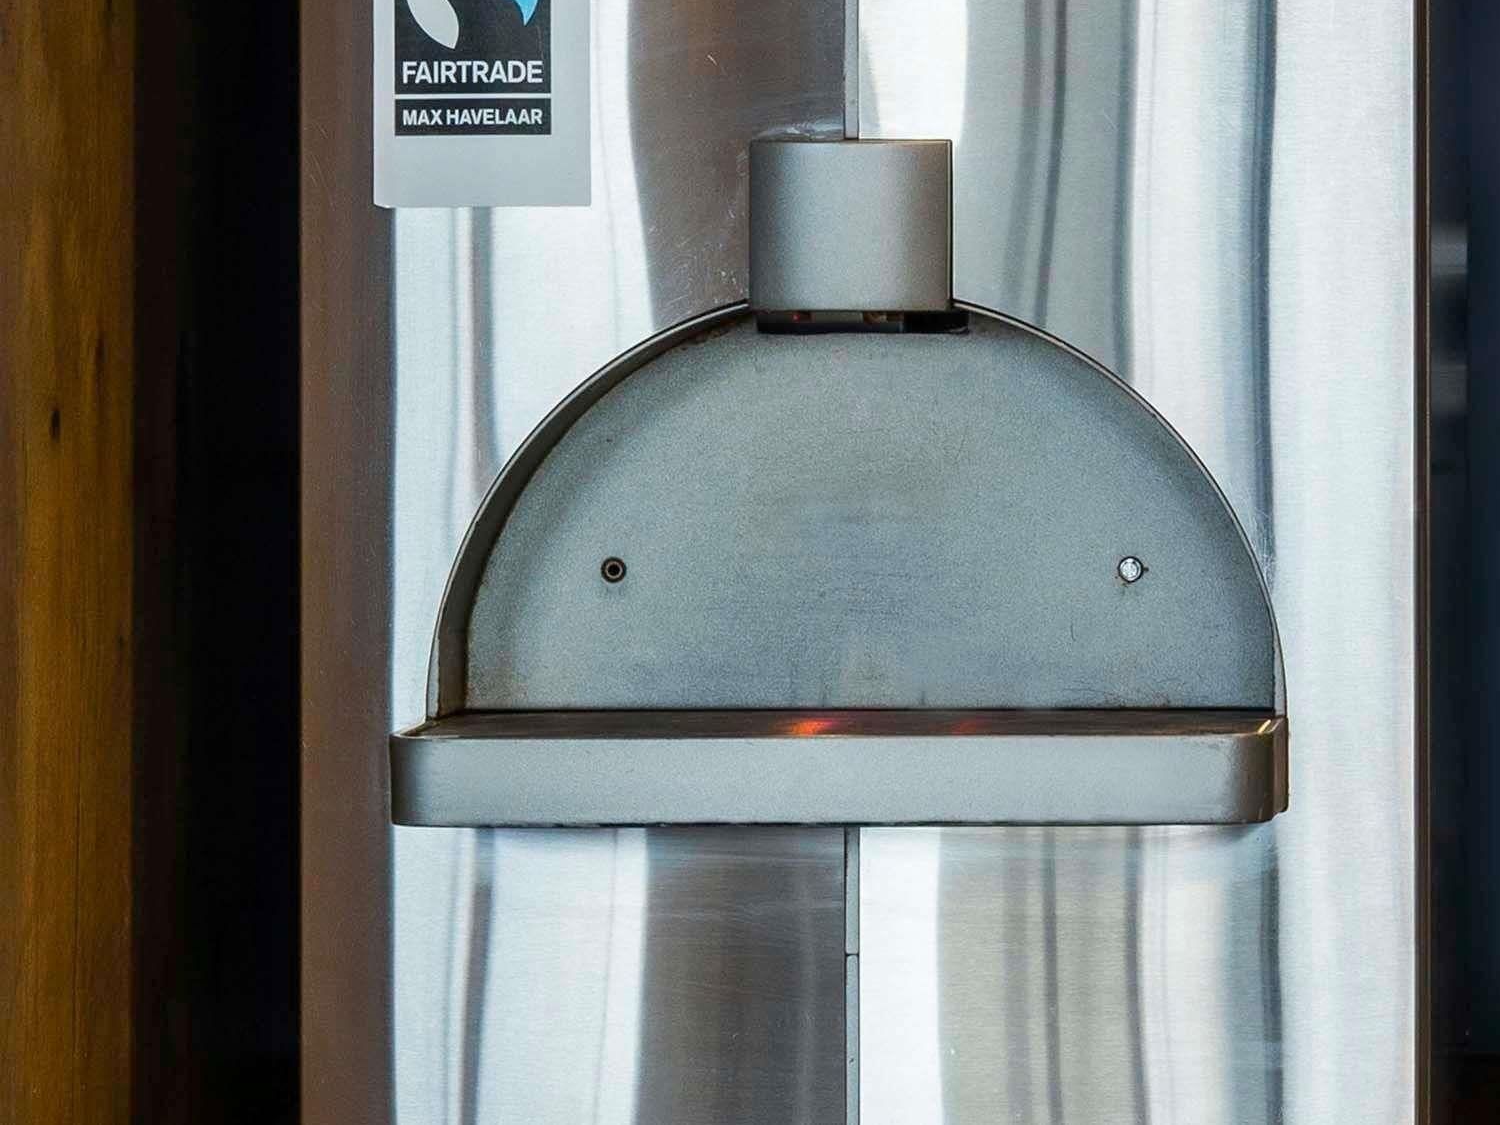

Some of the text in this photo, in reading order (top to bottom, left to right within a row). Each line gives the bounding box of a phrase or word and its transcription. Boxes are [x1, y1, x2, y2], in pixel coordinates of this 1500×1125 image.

[402, 60, 543, 84] FAIRTRADE
[402, 108, 543, 125] MAX HAVELAAR
